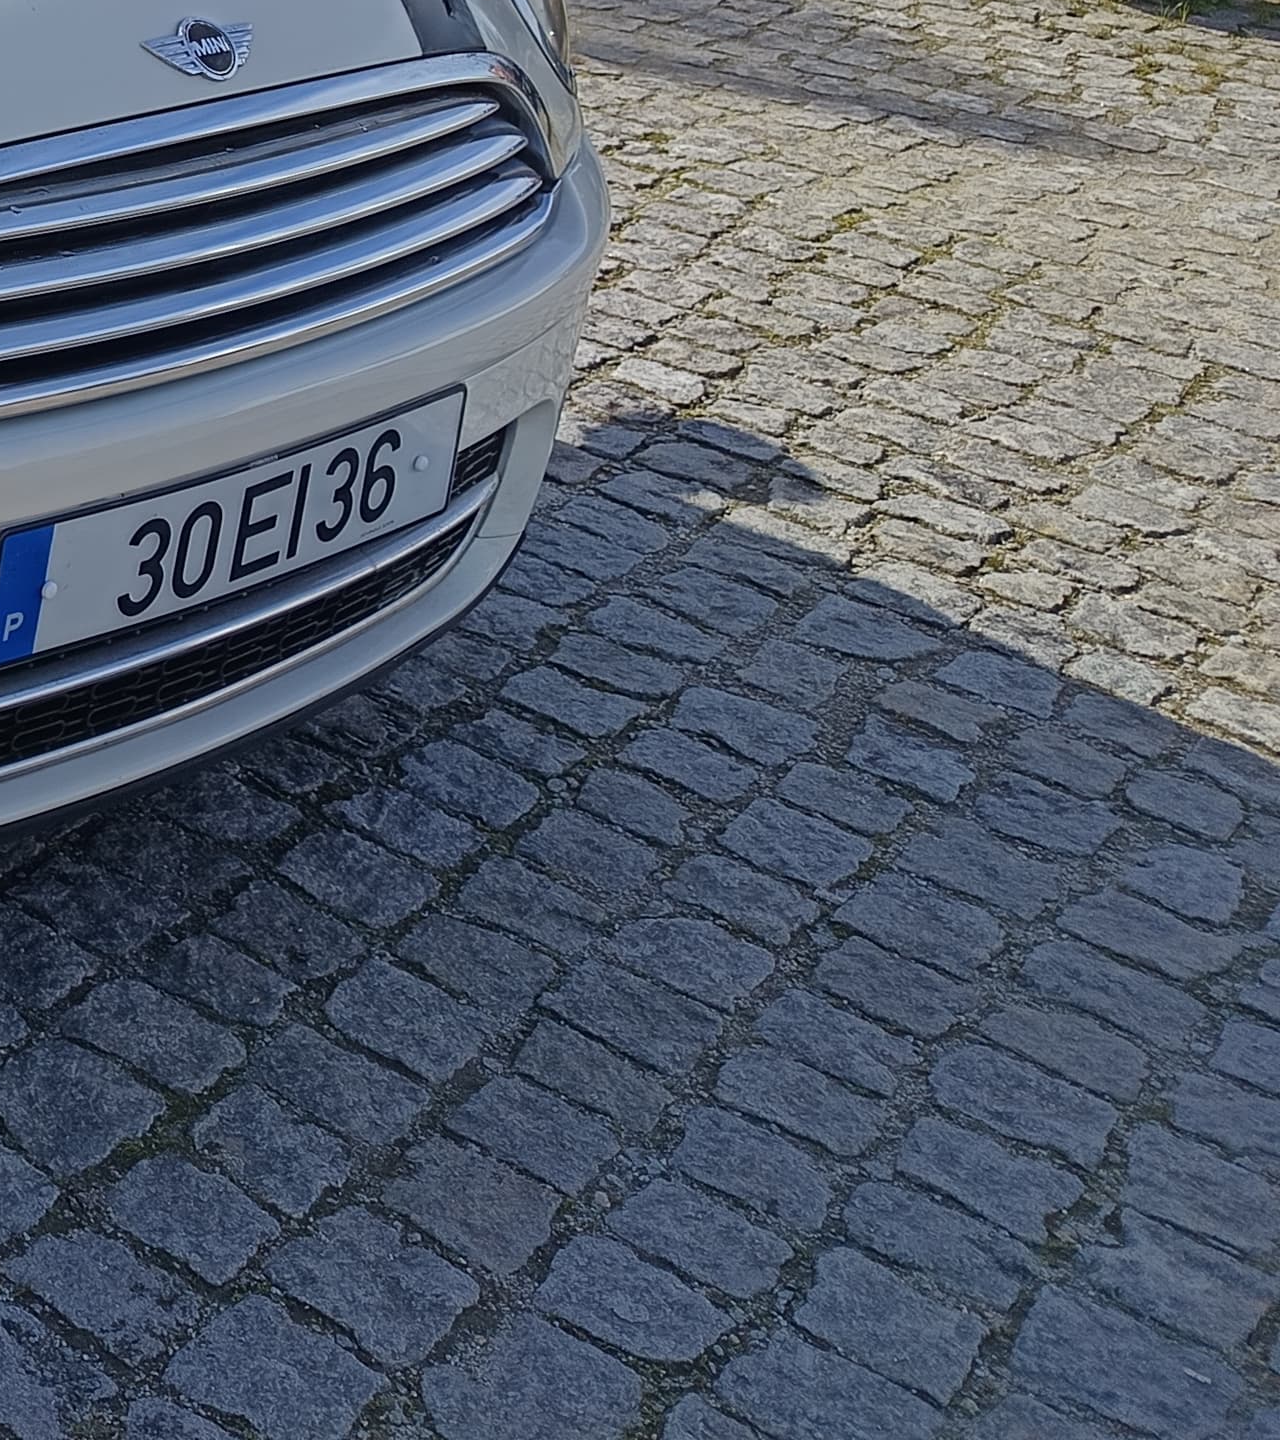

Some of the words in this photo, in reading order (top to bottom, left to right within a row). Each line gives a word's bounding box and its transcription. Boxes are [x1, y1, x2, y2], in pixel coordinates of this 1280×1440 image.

[192, 36, 230, 57] MINI
[117, 428, 402, 618] 30EI36
[2, 611, 24, 642] P
